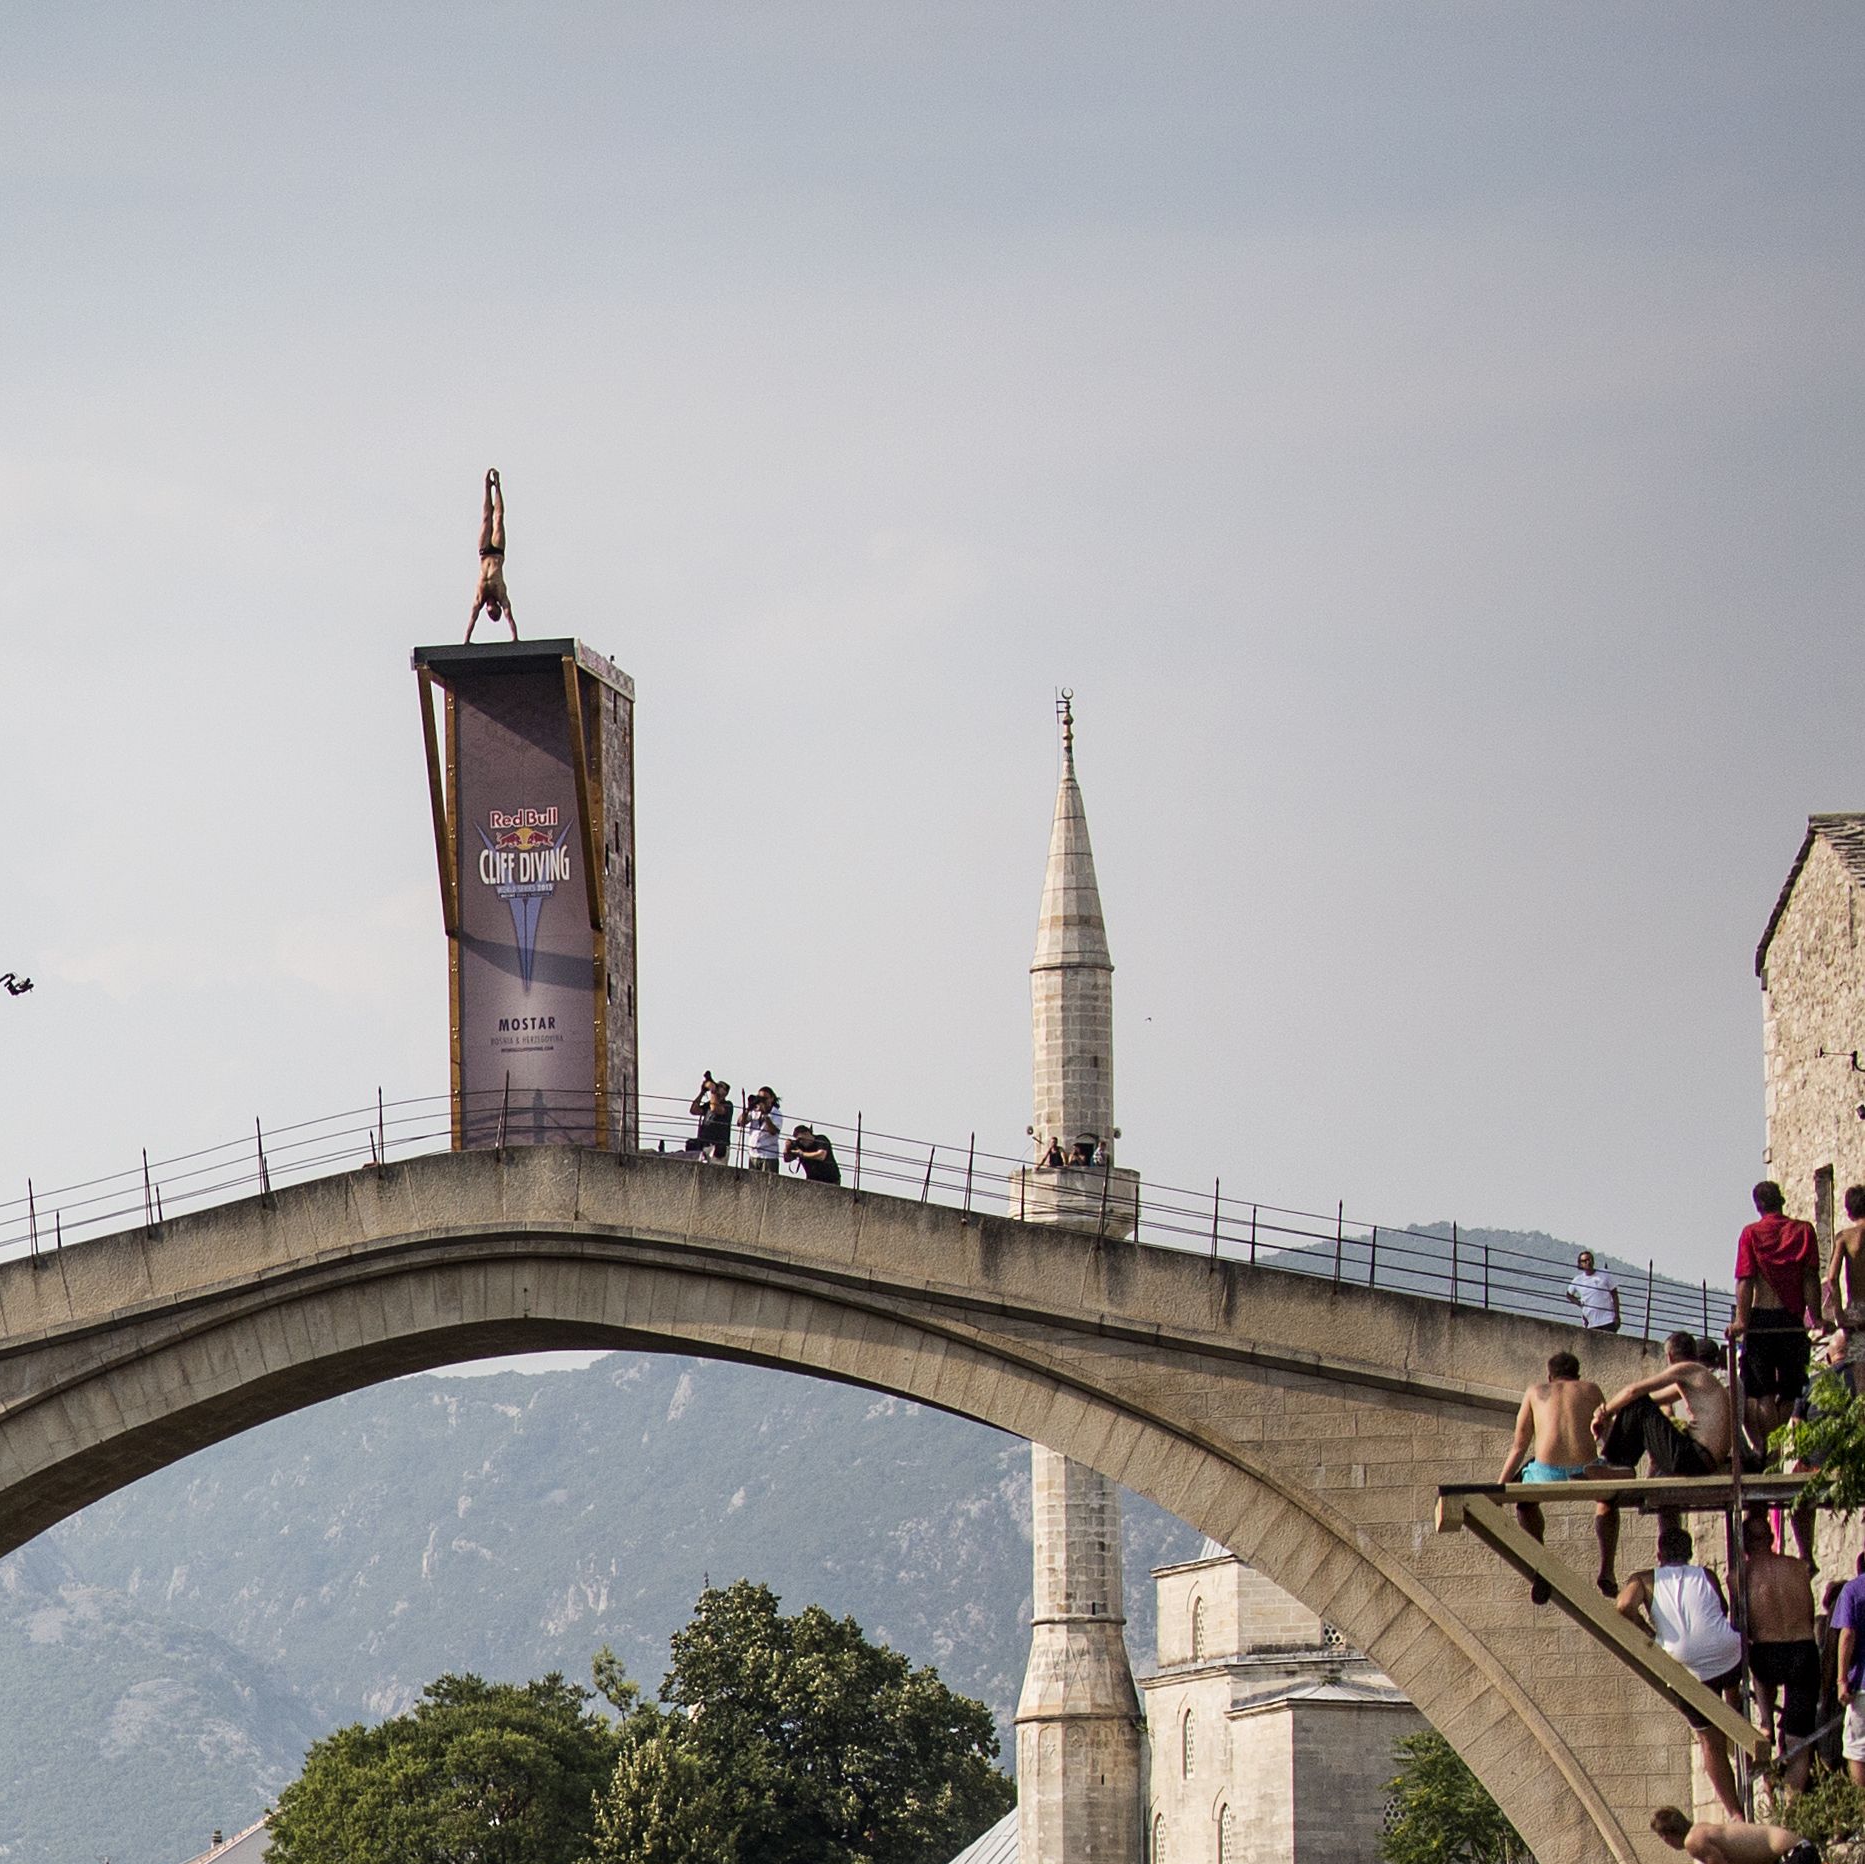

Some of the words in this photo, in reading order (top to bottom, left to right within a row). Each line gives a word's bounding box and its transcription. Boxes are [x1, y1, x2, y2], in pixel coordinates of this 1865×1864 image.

[490, 809, 523, 828] Red
[524, 806, 558, 827] Bull
[479, 849, 515, 884] CLIFF
[519, 845, 570, 883] DIVING
[537, 884, 553, 892] 2015
[498, 1017, 556, 1032] MOSTAR
